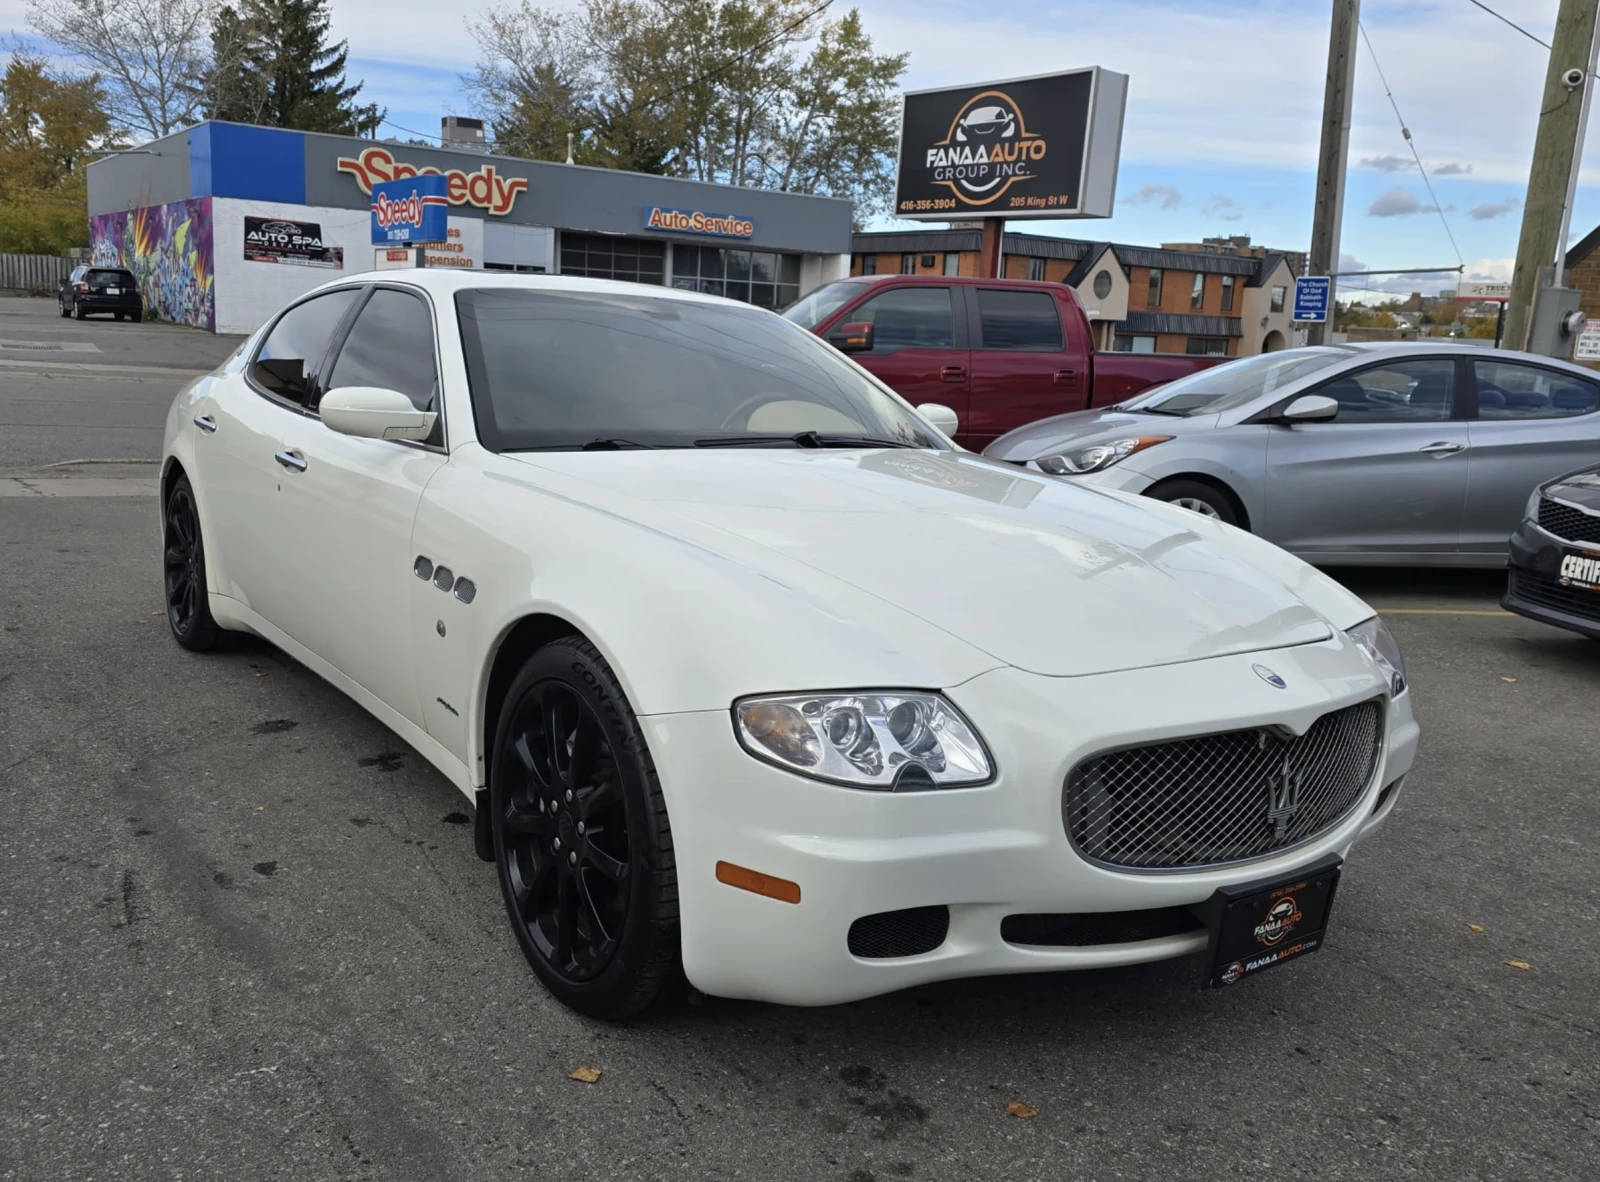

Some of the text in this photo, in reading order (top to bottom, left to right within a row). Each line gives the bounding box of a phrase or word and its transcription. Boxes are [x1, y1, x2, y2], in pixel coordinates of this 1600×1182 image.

[934, 162, 1031, 180] GROUP INC.
[337, 147, 528, 216] Sedy
[900, 198, 956, 211] 416-356-3904
[1010, 195, 1068, 208] 205 King St W
[371, 189, 448, 231] Speedy
[648, 207, 753, 237] Auto Service
[247, 231, 322, 246] AUTO SPA
[264, 240, 306, 250] DETAIL
[424, 254, 473, 267] spension
[1560, 554, 1600, 585] CERTIF
